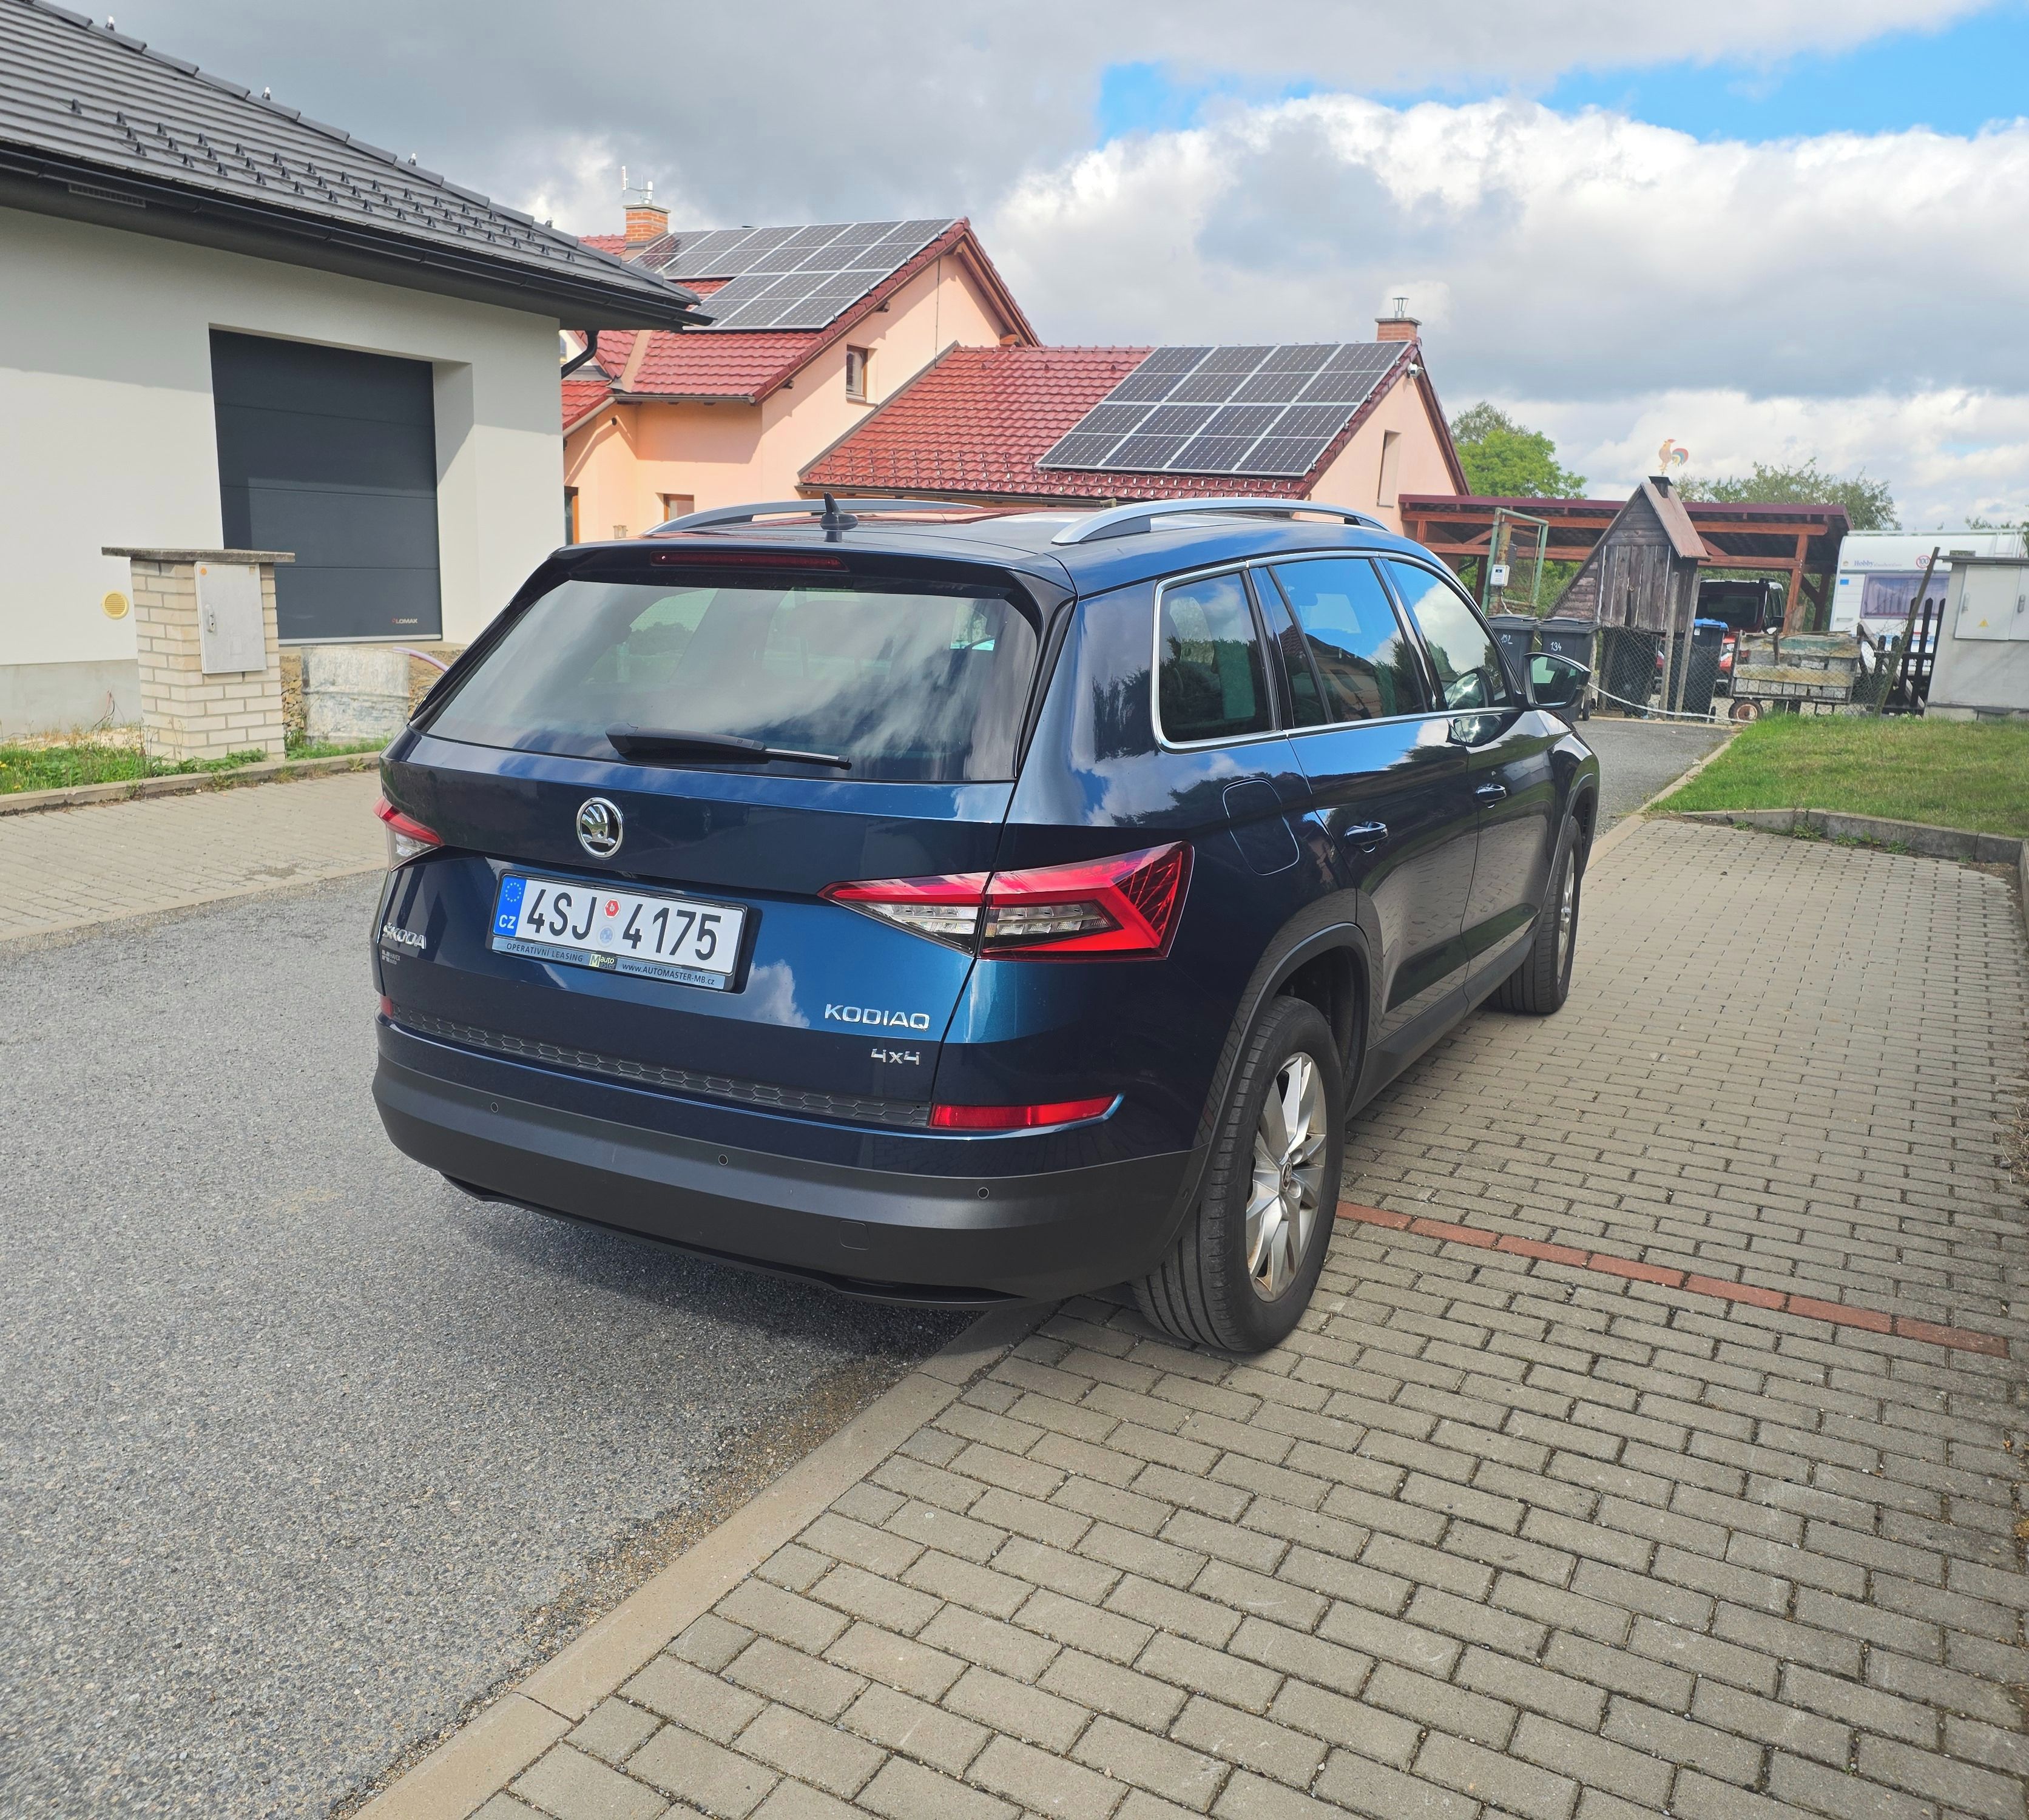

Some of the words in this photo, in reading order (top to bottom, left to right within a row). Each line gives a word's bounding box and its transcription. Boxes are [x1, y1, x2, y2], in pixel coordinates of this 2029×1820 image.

[1550, 641, 1562, 652] 134
[498, 914, 516, 929] CZ
[527, 889, 598, 940] 4SJ
[622, 903, 722, 961] 4175
[382, 922, 427, 949] ŠKODA
[507, 942, 550, 957] OPERATIVNÍ
[552, 951, 583, 962] LEASING
[622, 963, 715, 985] www.AUTOMASTER-MB.cz
[825, 1003, 930, 1031] KODIAQ
[871, 1048, 920, 1065] 4x4
